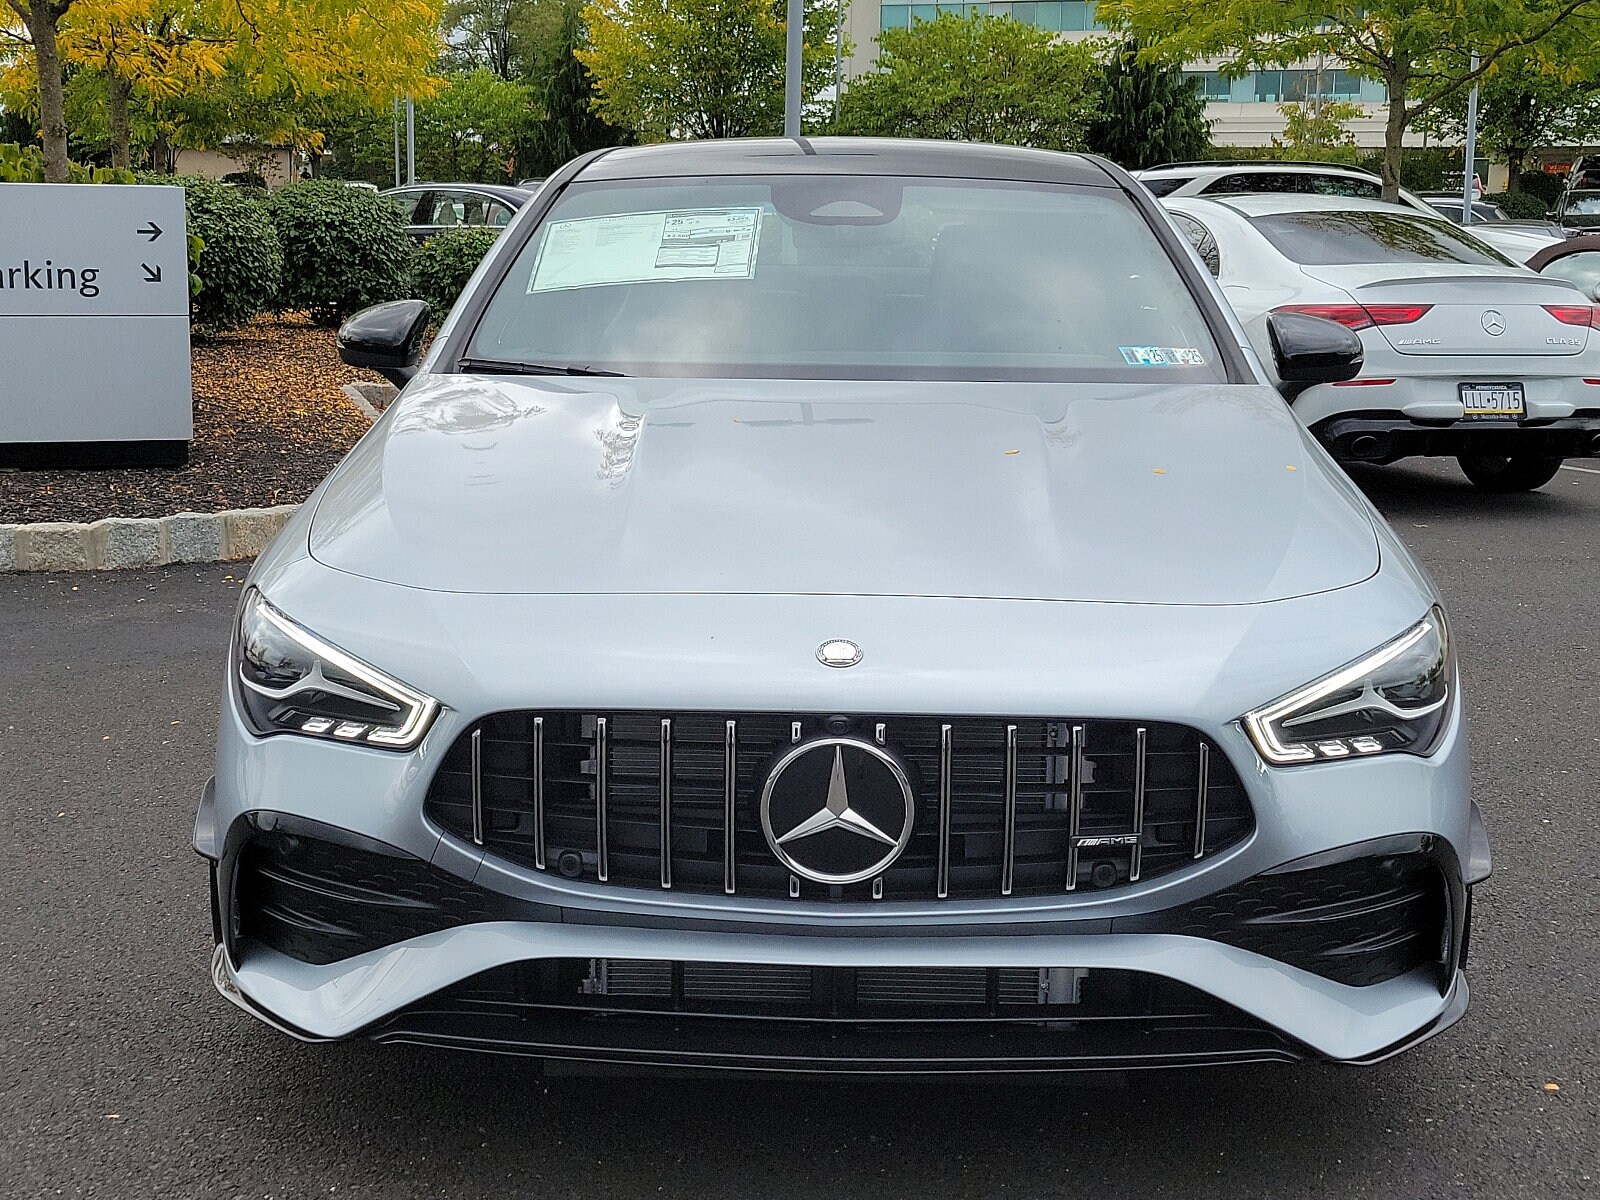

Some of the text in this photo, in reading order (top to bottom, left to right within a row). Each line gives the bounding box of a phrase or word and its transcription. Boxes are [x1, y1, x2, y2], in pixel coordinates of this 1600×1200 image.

[0, 260, 100, 298] rking
[1569, 338, 1581, 346] 35
[1096, 836, 1138, 845] AMG
